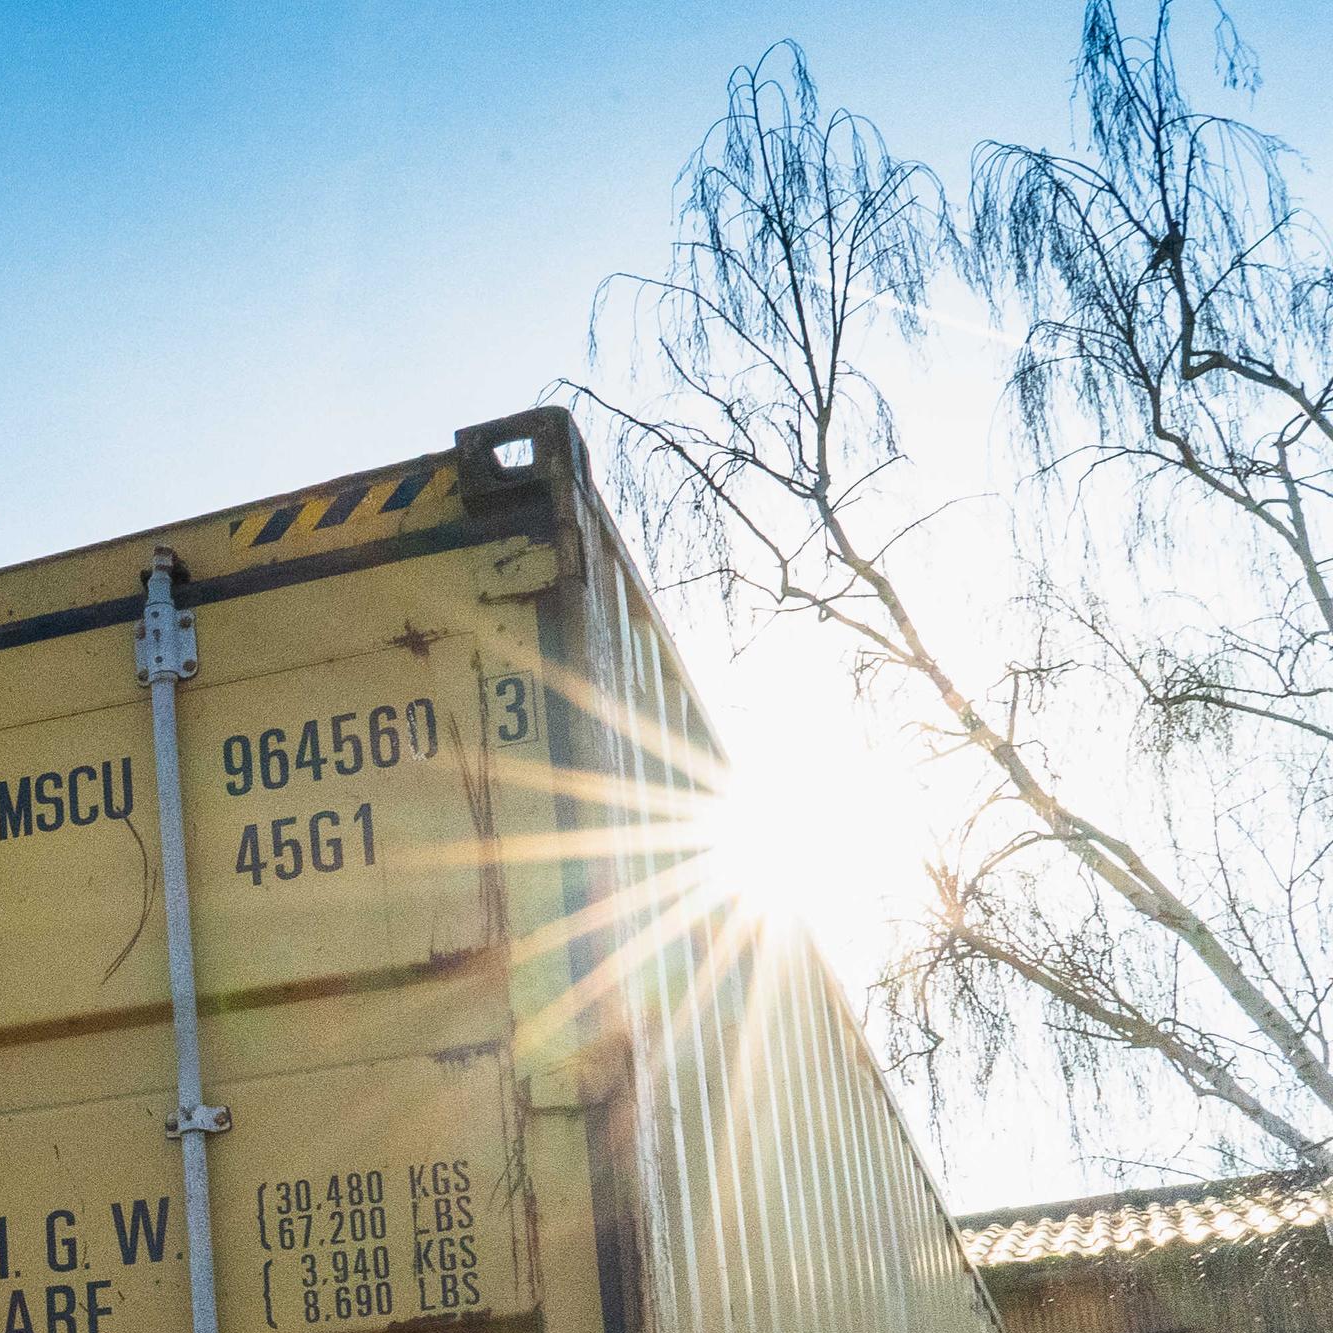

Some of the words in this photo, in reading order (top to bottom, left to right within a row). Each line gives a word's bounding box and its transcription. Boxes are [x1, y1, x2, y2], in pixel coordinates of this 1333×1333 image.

[223, 698, 438, 797] 964560
[496, 677, 530, 743] 3
[235, 803, 377, 887] 45G1
[409, 1160, 471, 1200] KGS
[412, 1196, 474, 1237] LBS
[414, 1235, 478, 1277] KGS
[419, 1272, 481, 1311] LBS
